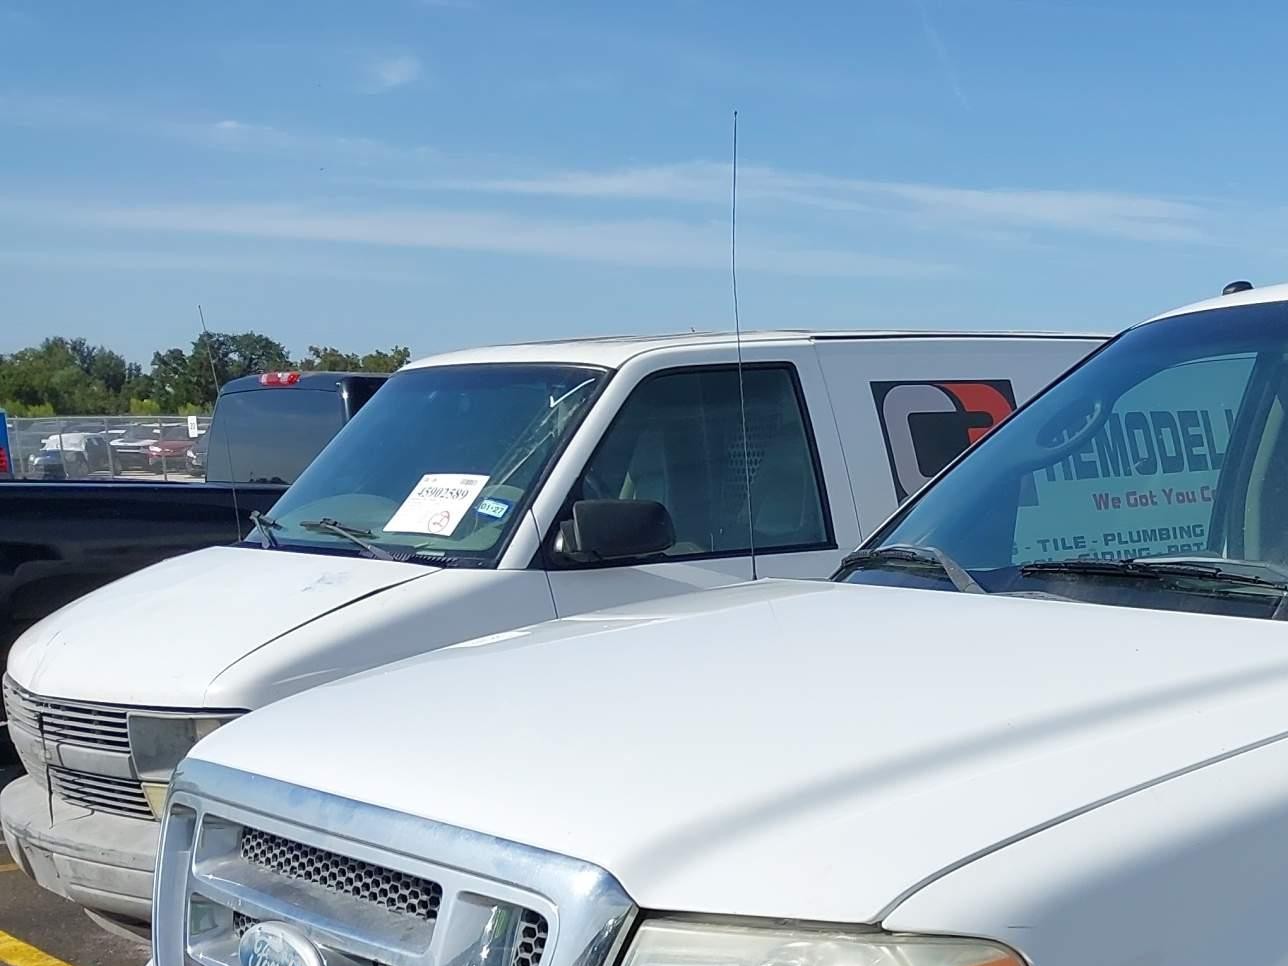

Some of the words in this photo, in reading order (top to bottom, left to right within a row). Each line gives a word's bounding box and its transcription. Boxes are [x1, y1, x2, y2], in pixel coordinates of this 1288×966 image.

[1092, 492, 1121, 511] We
[1126, 490, 1158, 508] Got
[1162, 487, 1197, 505] You
[1037, 535, 1086, 552] TILE
[1103, 524, 1204, 546] PLUMBING
